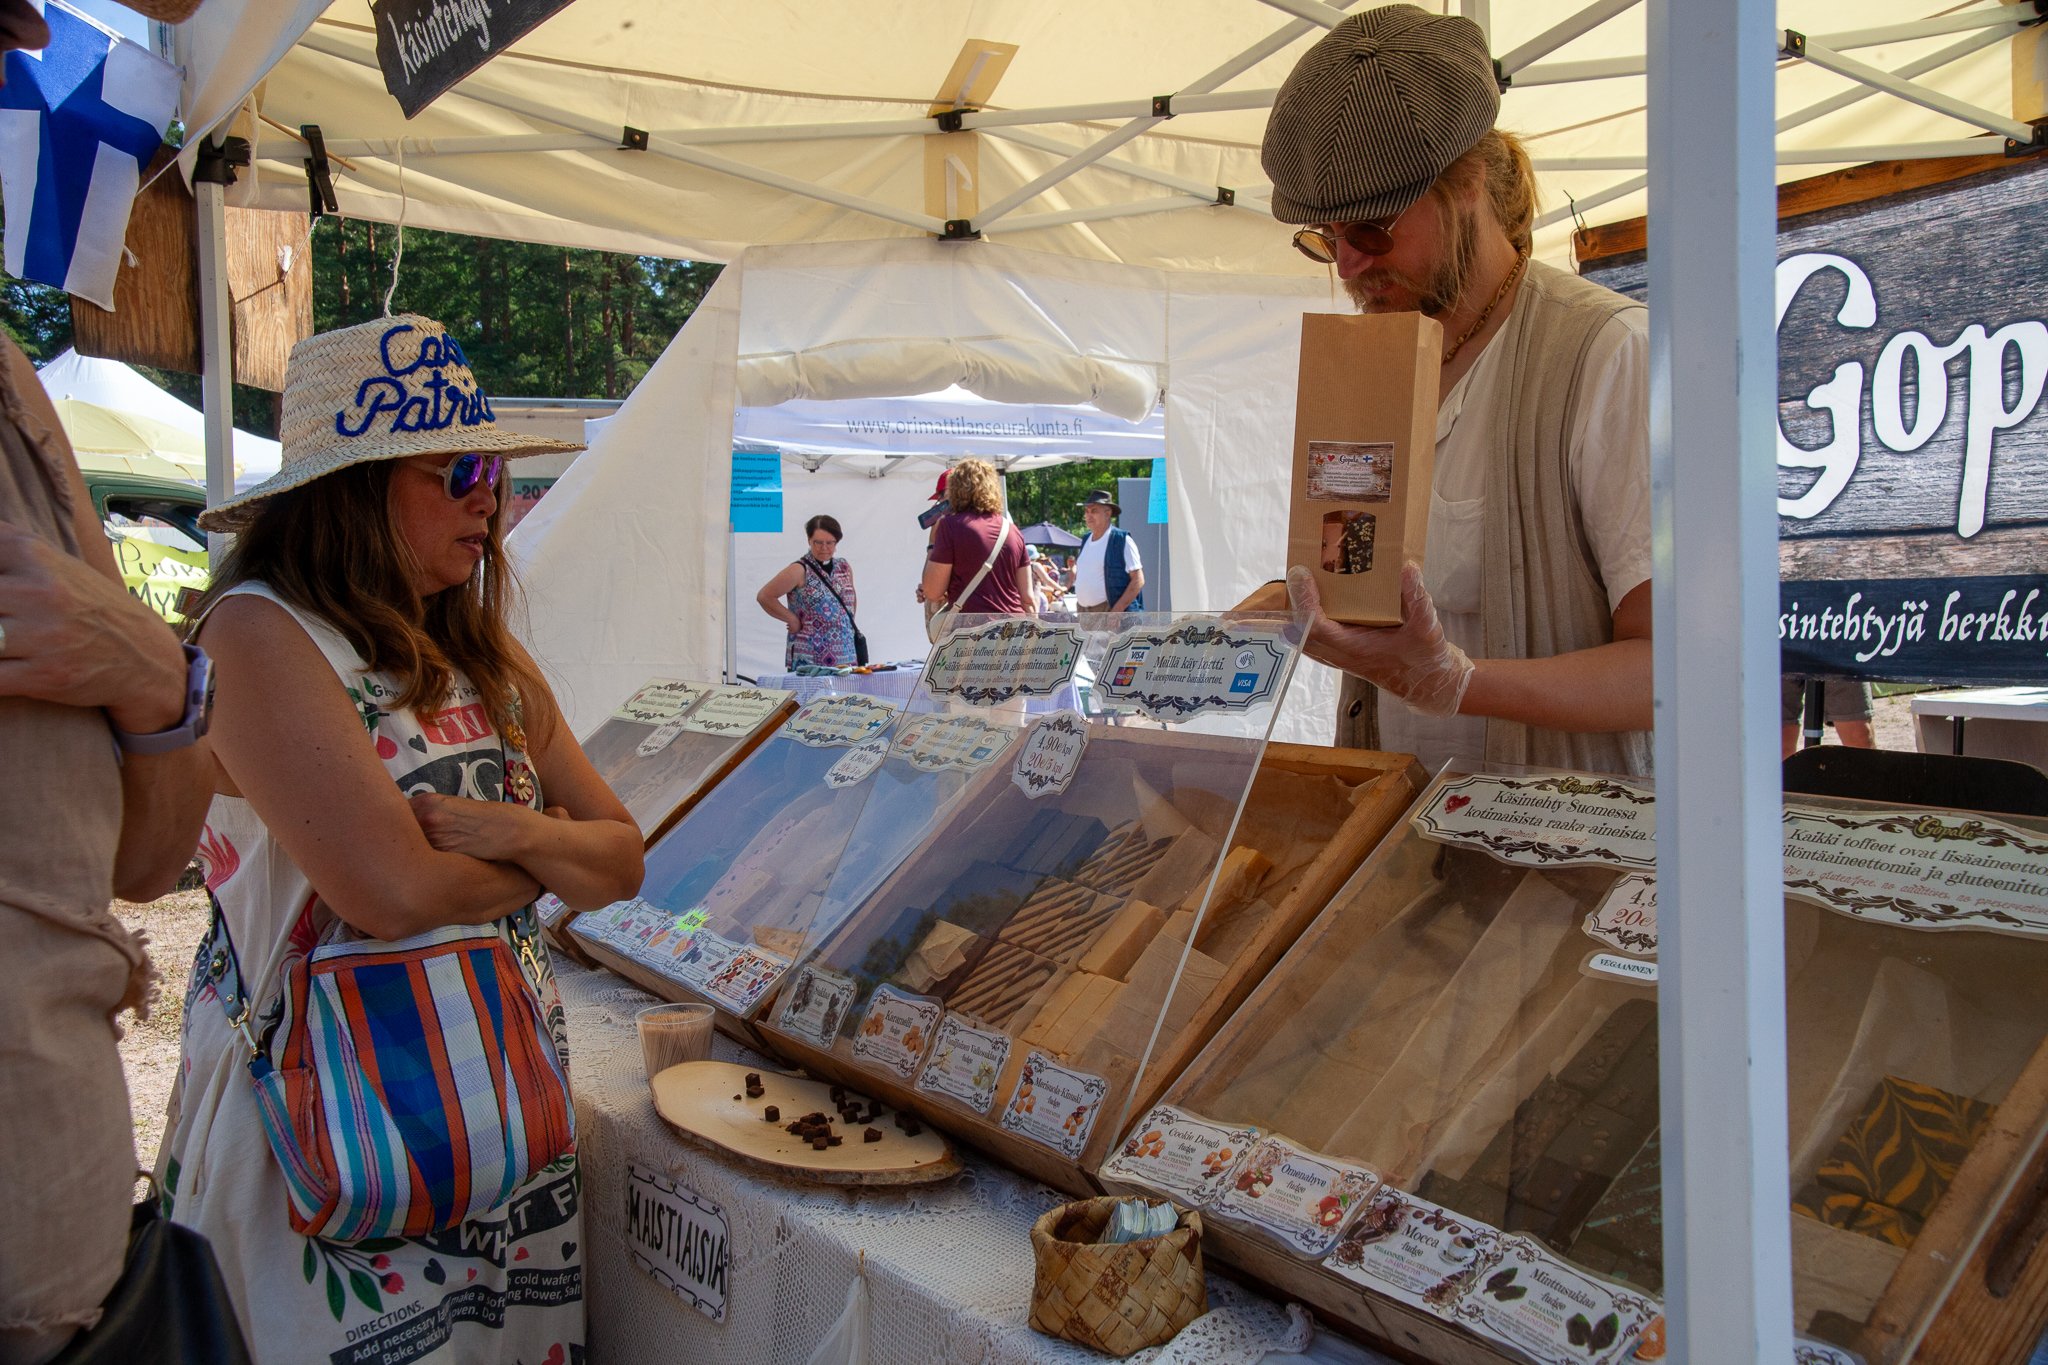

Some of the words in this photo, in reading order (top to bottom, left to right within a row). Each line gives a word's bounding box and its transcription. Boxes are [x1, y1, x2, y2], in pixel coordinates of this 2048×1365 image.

[846, 416, 1084, 437] www.orimattilanseurakunta.fi
[1153, 655, 1181, 668] Meillä
[1181, 655, 1198, 672] käy
[1237, 679, 1252, 688] VISA
[1557, 776, 1603, 798] Gopala
[1493, 790, 1567, 813] Käsintehty
[1566, 798, 1638, 821] Suomessa
[1463, 805, 1543, 828] kotimaisista
[1545, 818, 1648, 842] raaka-aineista.
[1912, 814, 1978, 843] Gopala
[1787, 827, 1842, 846] Kaikki
[1842, 834, 1897, 855] toffeet
[1898, 845, 1938, 862] ovat
[1939, 848, 2048, 876] lisäaineetto
[1921, 865, 1944, 882] ja
[1944, 868, 2048, 897] gluteenitto
[1600, 958, 1655, 975] VEGAANINEN
[1168, 1127, 1195, 1142] Cookie
[1194, 1134, 1220, 1150] Dough
[1281, 1163, 1327, 1188] Omenahyve
[627, 1184, 726, 1297] MAISTIAISIA
[1401, 1224, 1440, 1249] Mocca
[514, 1272, 539, 1285] cold
[1529, 1267, 1596, 1310] Minttusuklaa
[525, 1287, 563, 1302] Power,
[564, 1283, 581, 1298] Salt
[345, 1299, 426, 1344] DIRECTIONS.
[353, 1340, 381, 1363] Add
[383, 1314, 437, 1349] necessary
[451, 1290, 475, 1305] make
[477, 1291, 485, 1302] a
[382, 1343, 415, 1365] Bake
[416, 1325, 448, 1353] quickly
[450, 1304, 479, 1319] oven.
